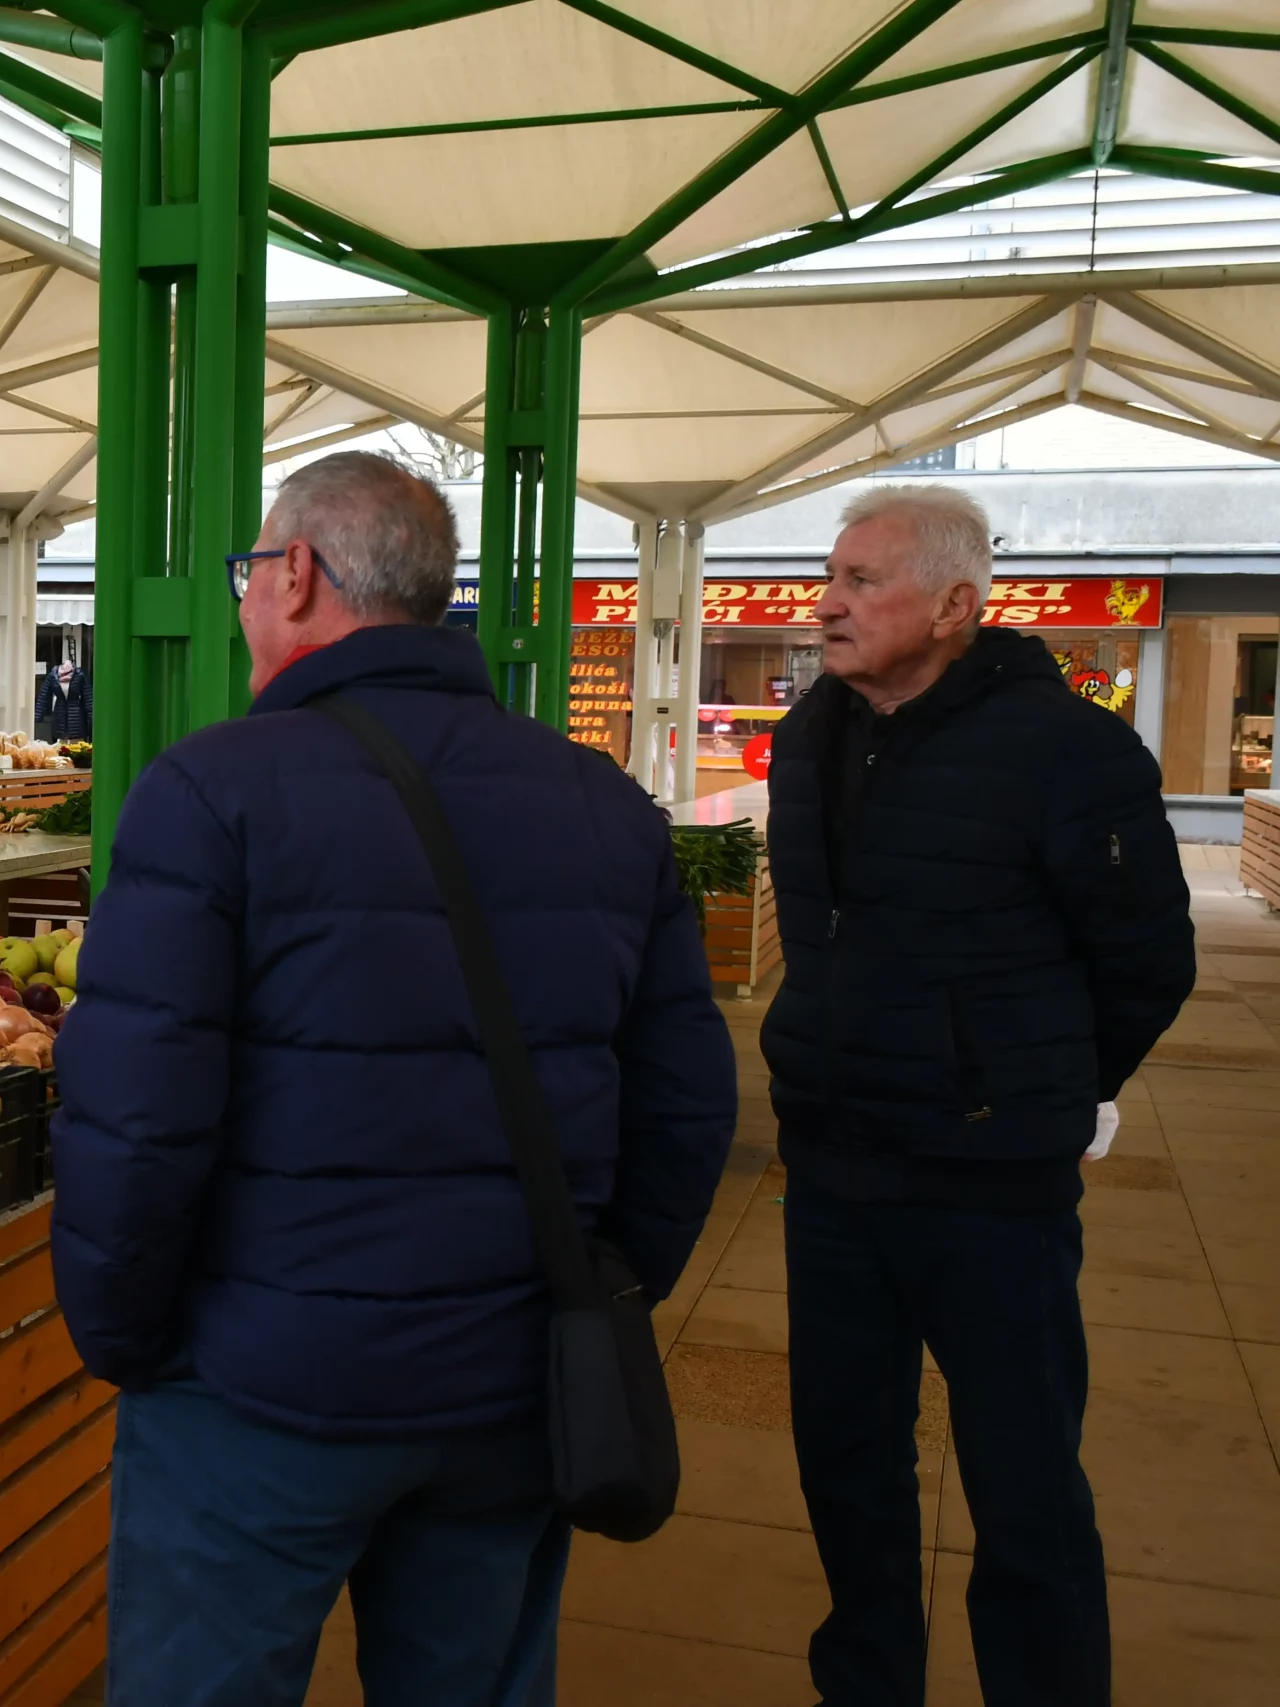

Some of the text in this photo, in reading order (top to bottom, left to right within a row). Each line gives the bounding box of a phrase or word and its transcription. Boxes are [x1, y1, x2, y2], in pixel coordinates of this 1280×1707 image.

[574, 629, 633, 643] JEŽE
[570, 645, 627, 656] ESO:
[569, 663, 618, 677] ilića
[569, 682, 627, 695] okoši
[569, 700, 633, 712] opuna
[568, 716, 605, 727] ura
